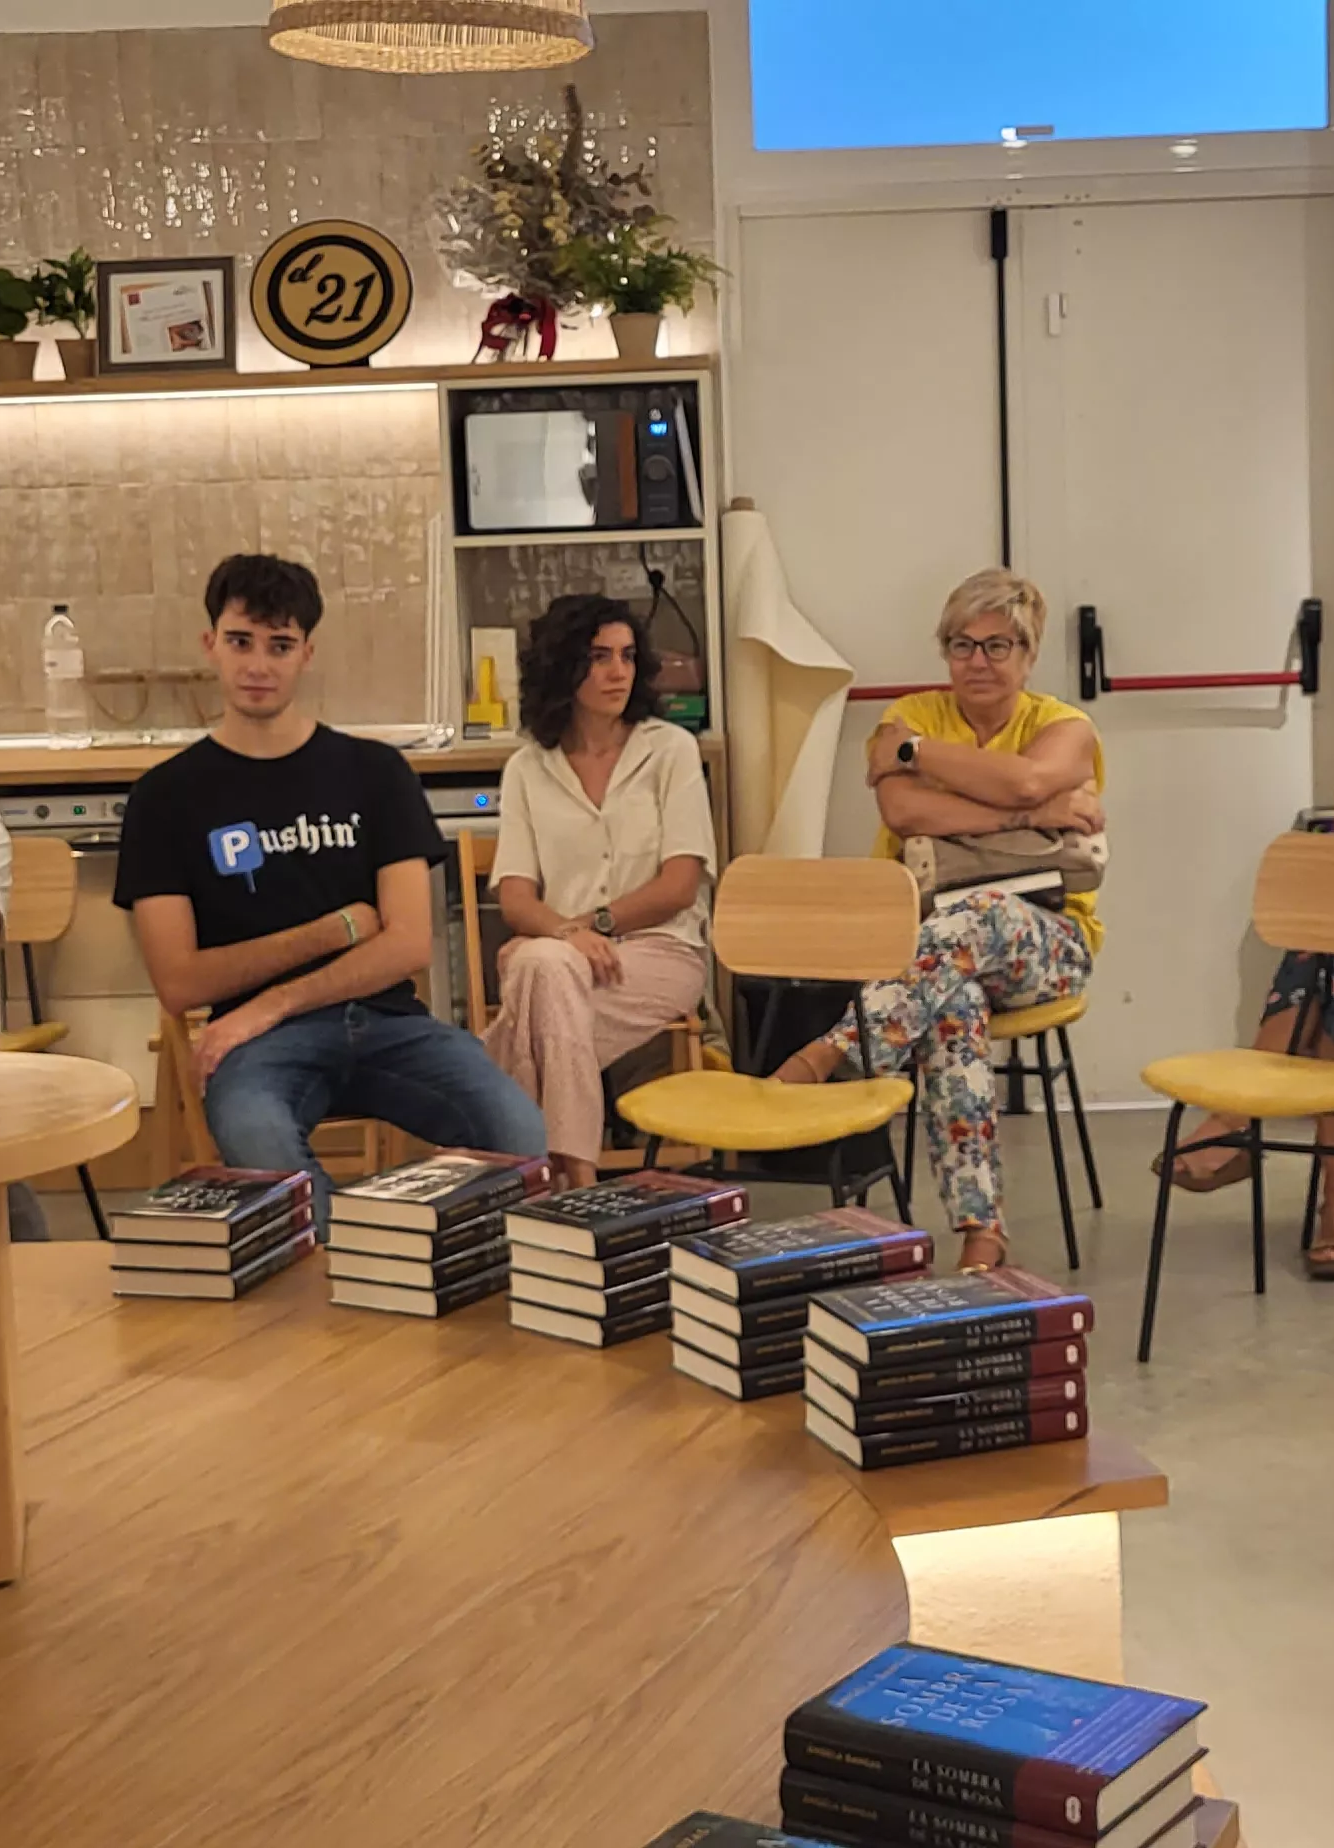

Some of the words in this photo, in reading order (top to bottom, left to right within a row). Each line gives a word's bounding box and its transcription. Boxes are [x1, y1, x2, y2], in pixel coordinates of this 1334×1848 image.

[305, 272, 377, 327] 21
[912, 1758, 931, 1776] LA
[936, 1764, 1002, 1792] SOMBRA
